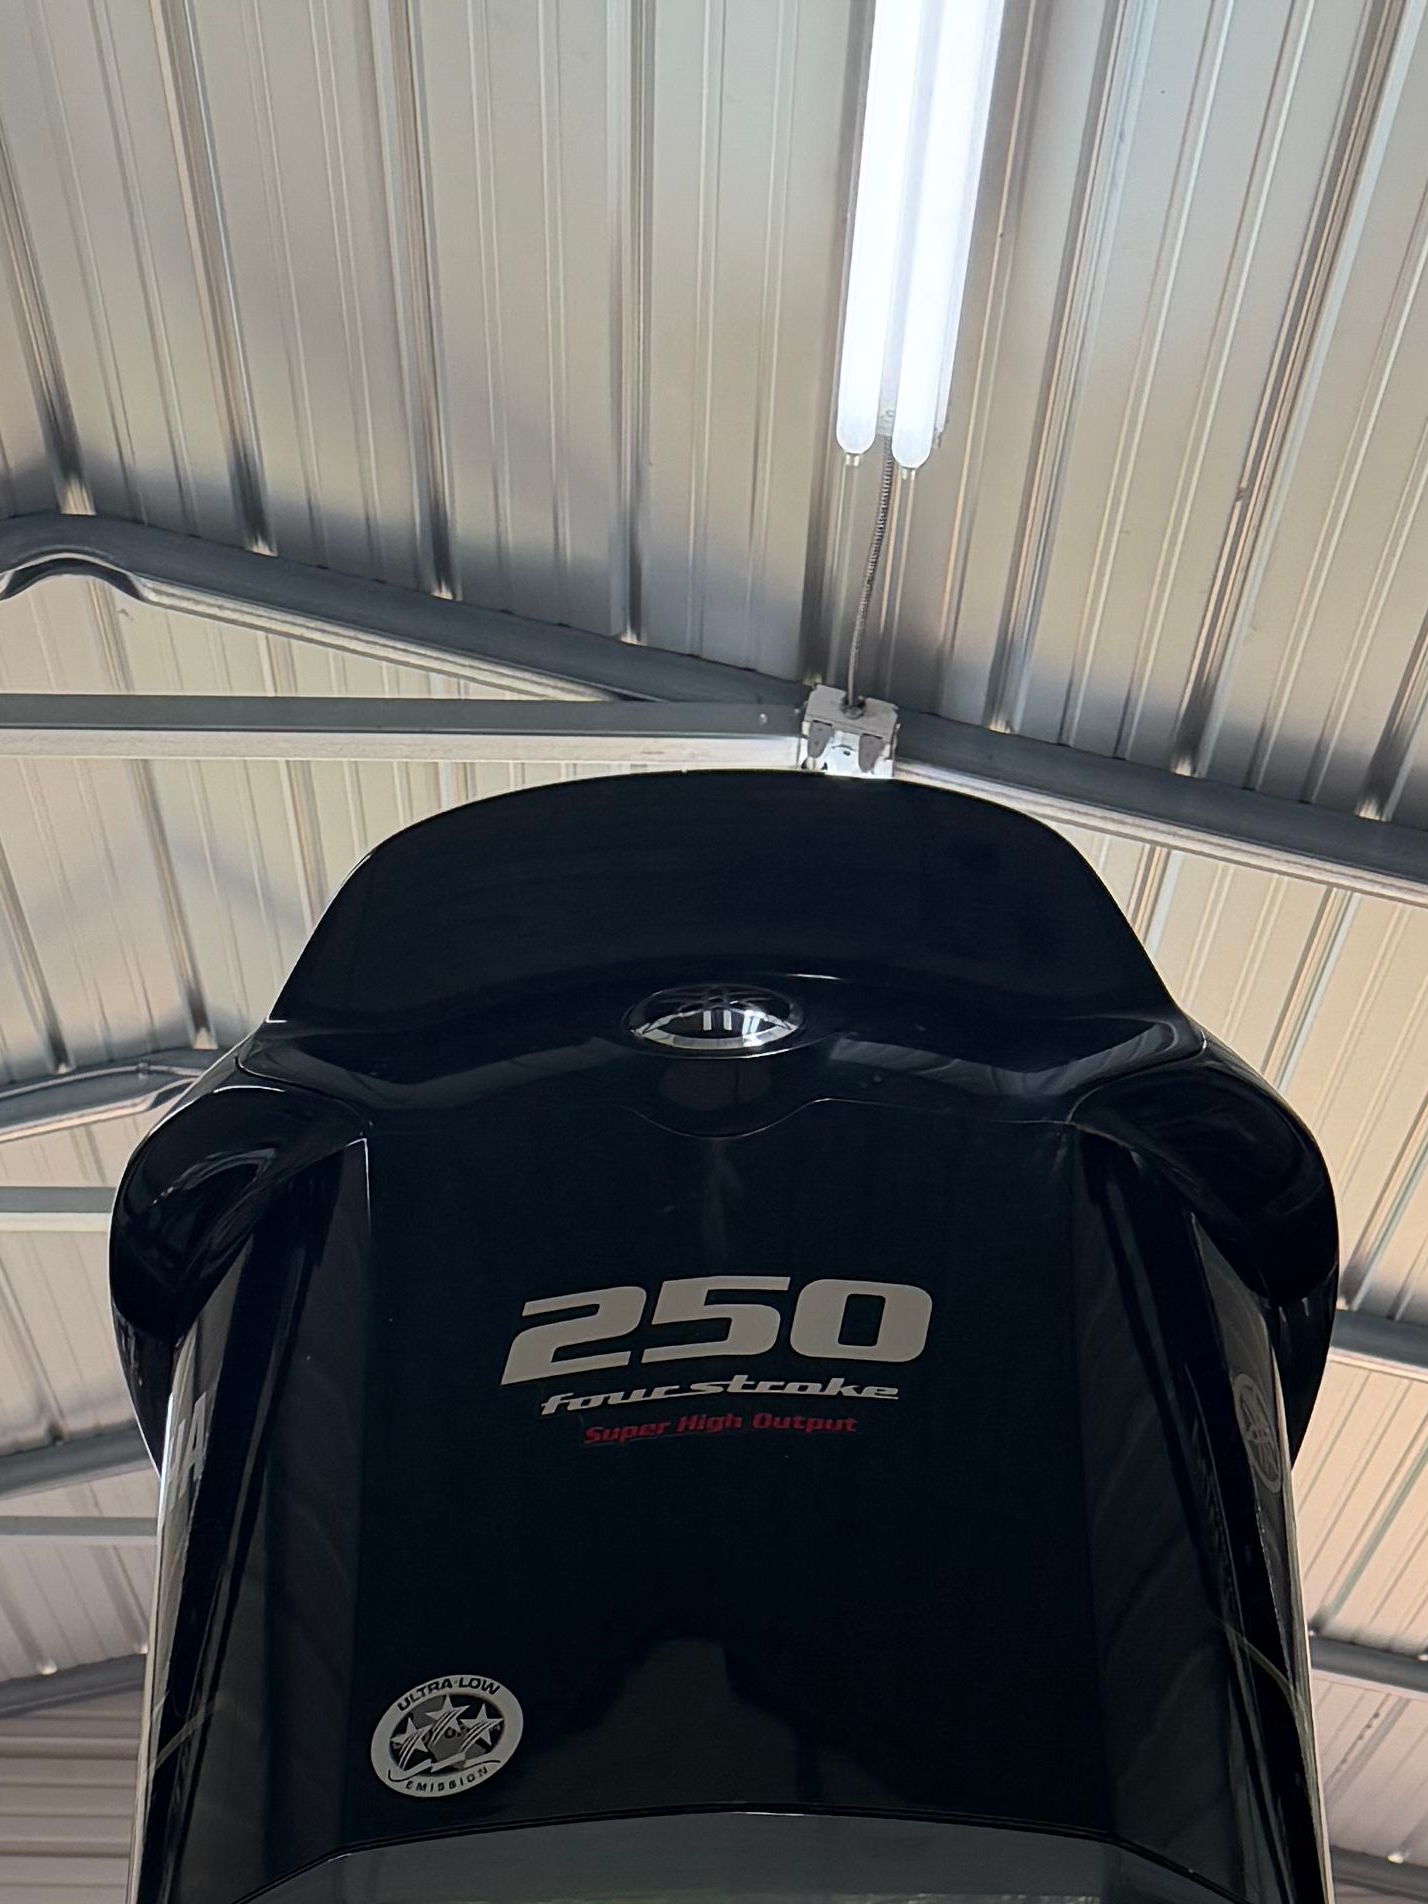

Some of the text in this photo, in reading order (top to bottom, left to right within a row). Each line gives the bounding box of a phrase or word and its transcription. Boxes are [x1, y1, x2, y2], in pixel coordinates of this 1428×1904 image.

[500, 1275, 933, 1385] 250
[583, 1411, 859, 1445] Super High Output
[404, 1766, 489, 1793] EMISSION
